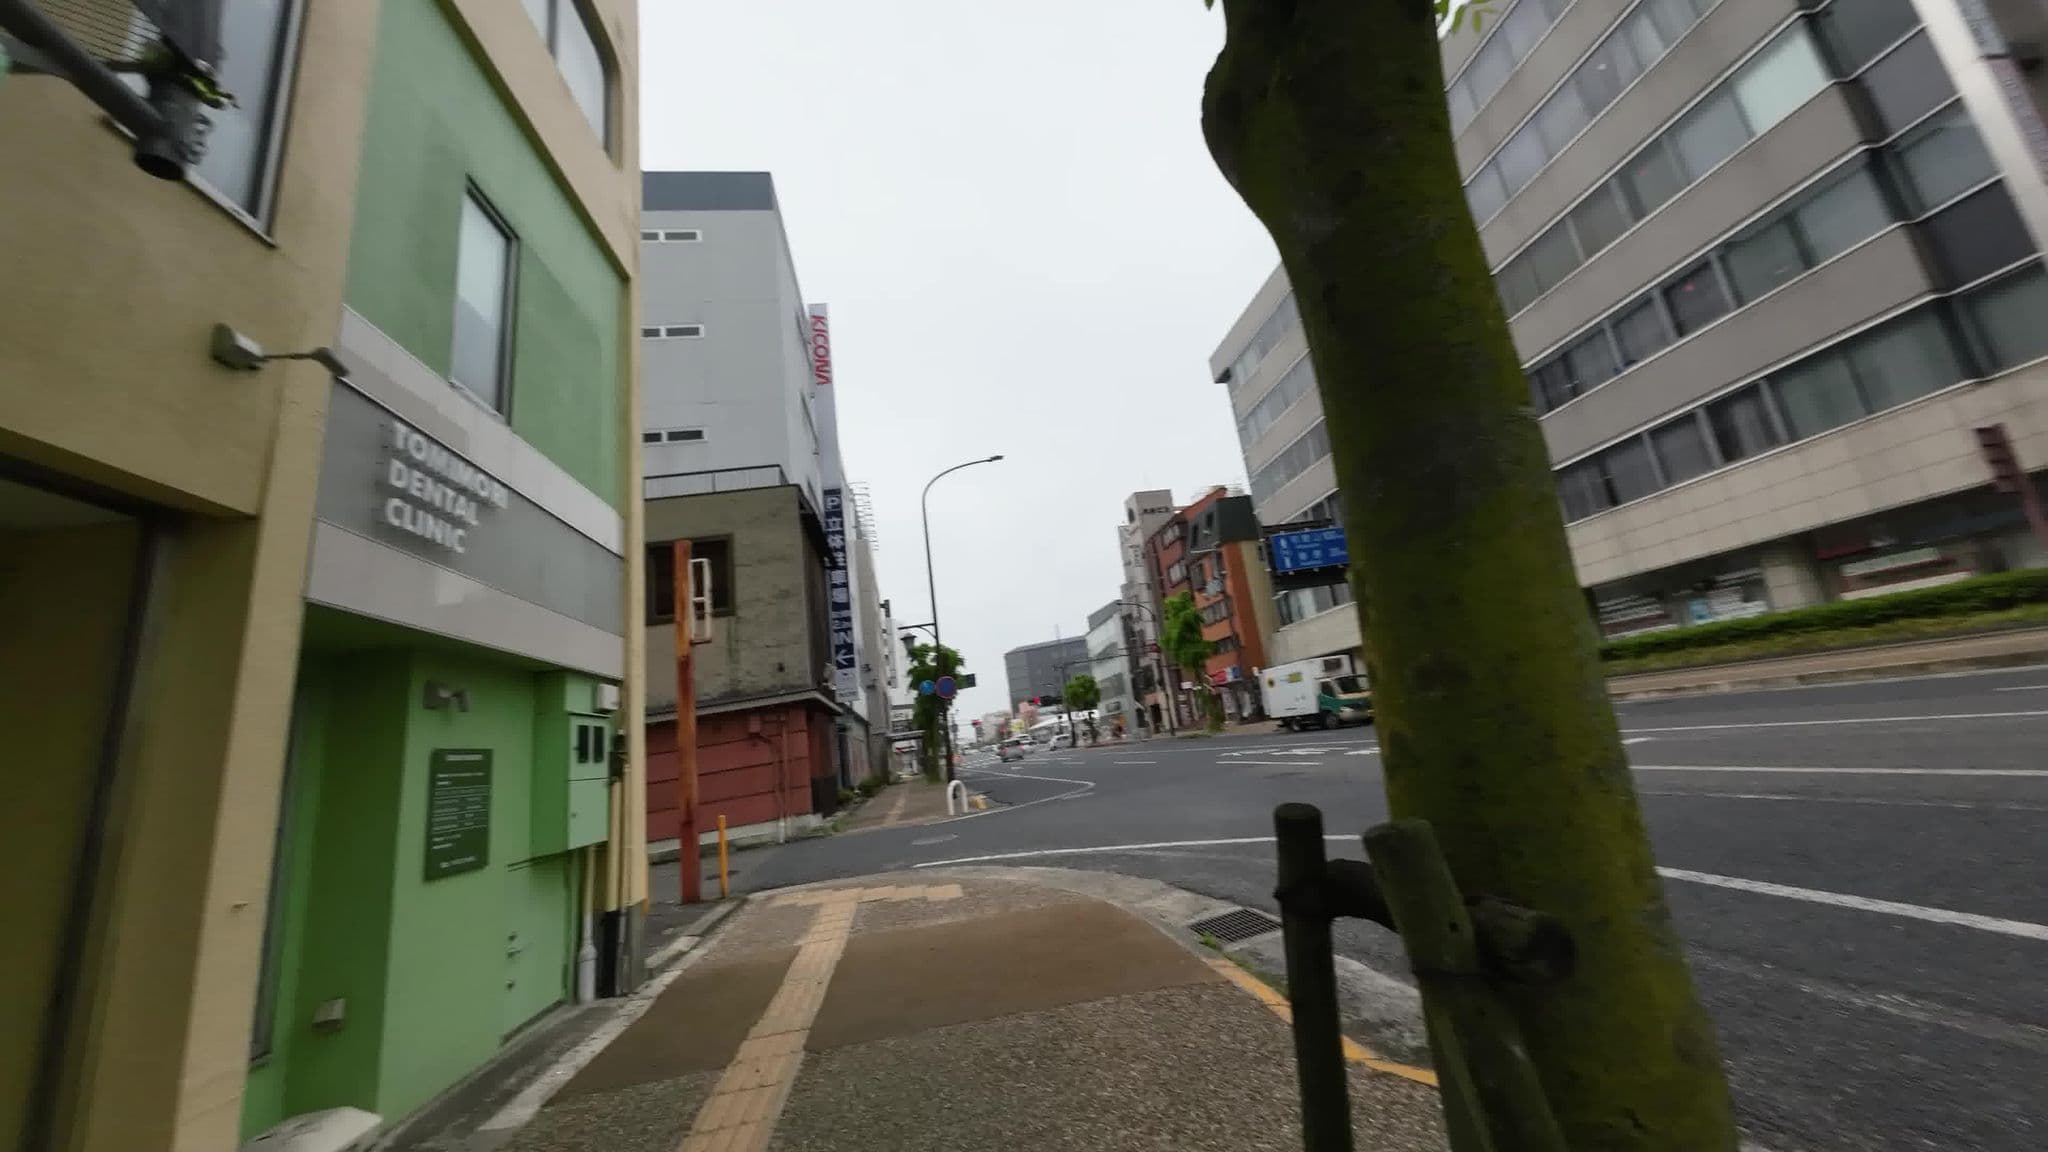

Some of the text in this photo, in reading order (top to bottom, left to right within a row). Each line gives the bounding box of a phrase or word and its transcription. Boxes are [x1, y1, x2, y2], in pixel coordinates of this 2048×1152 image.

[811, 315, 832, 385] KICONA
[386, 497, 466, 553] CLINIC
[388, 458, 479, 526] DENTAL
